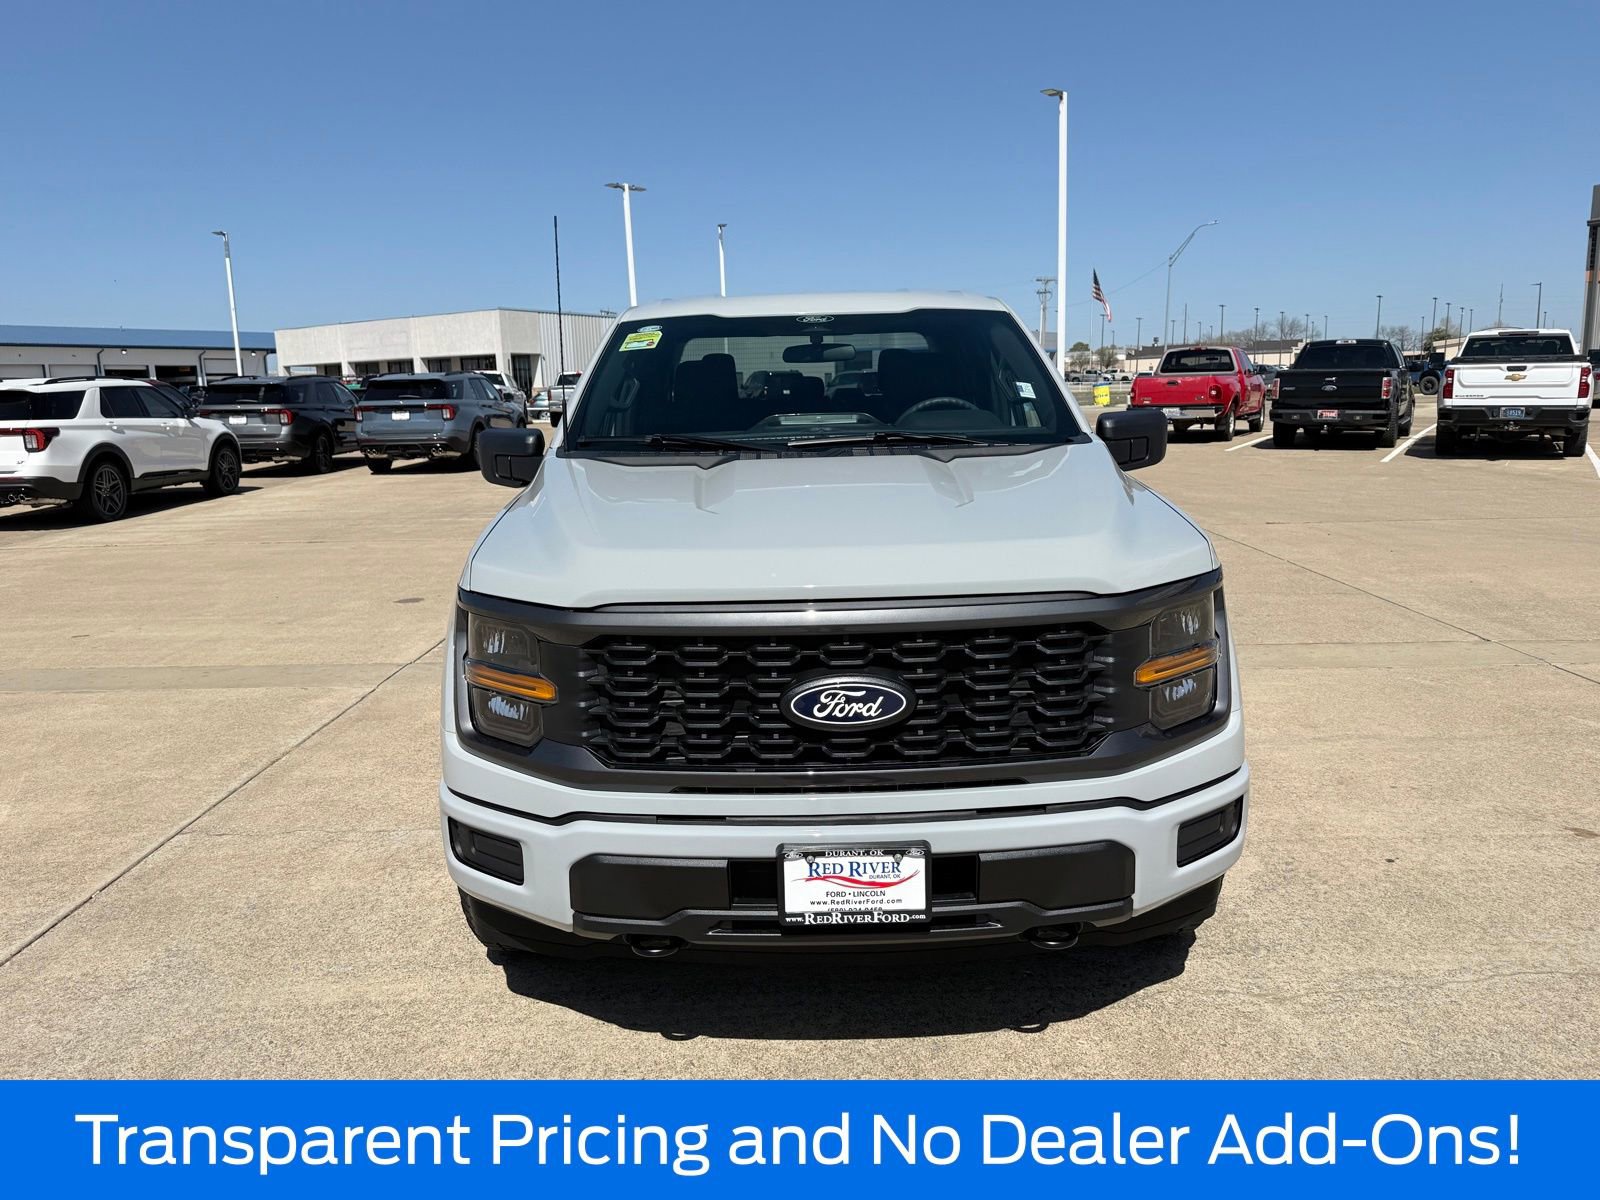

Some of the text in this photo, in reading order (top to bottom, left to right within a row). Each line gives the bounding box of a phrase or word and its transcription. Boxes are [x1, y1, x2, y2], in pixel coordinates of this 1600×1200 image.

[813, 690, 884, 718] Ford
[825, 849, 885, 858] DURANT, OK
[808, 860, 902, 878] RED RIVER
[810, 898, 903, 906] www.RedRiverFord.com
